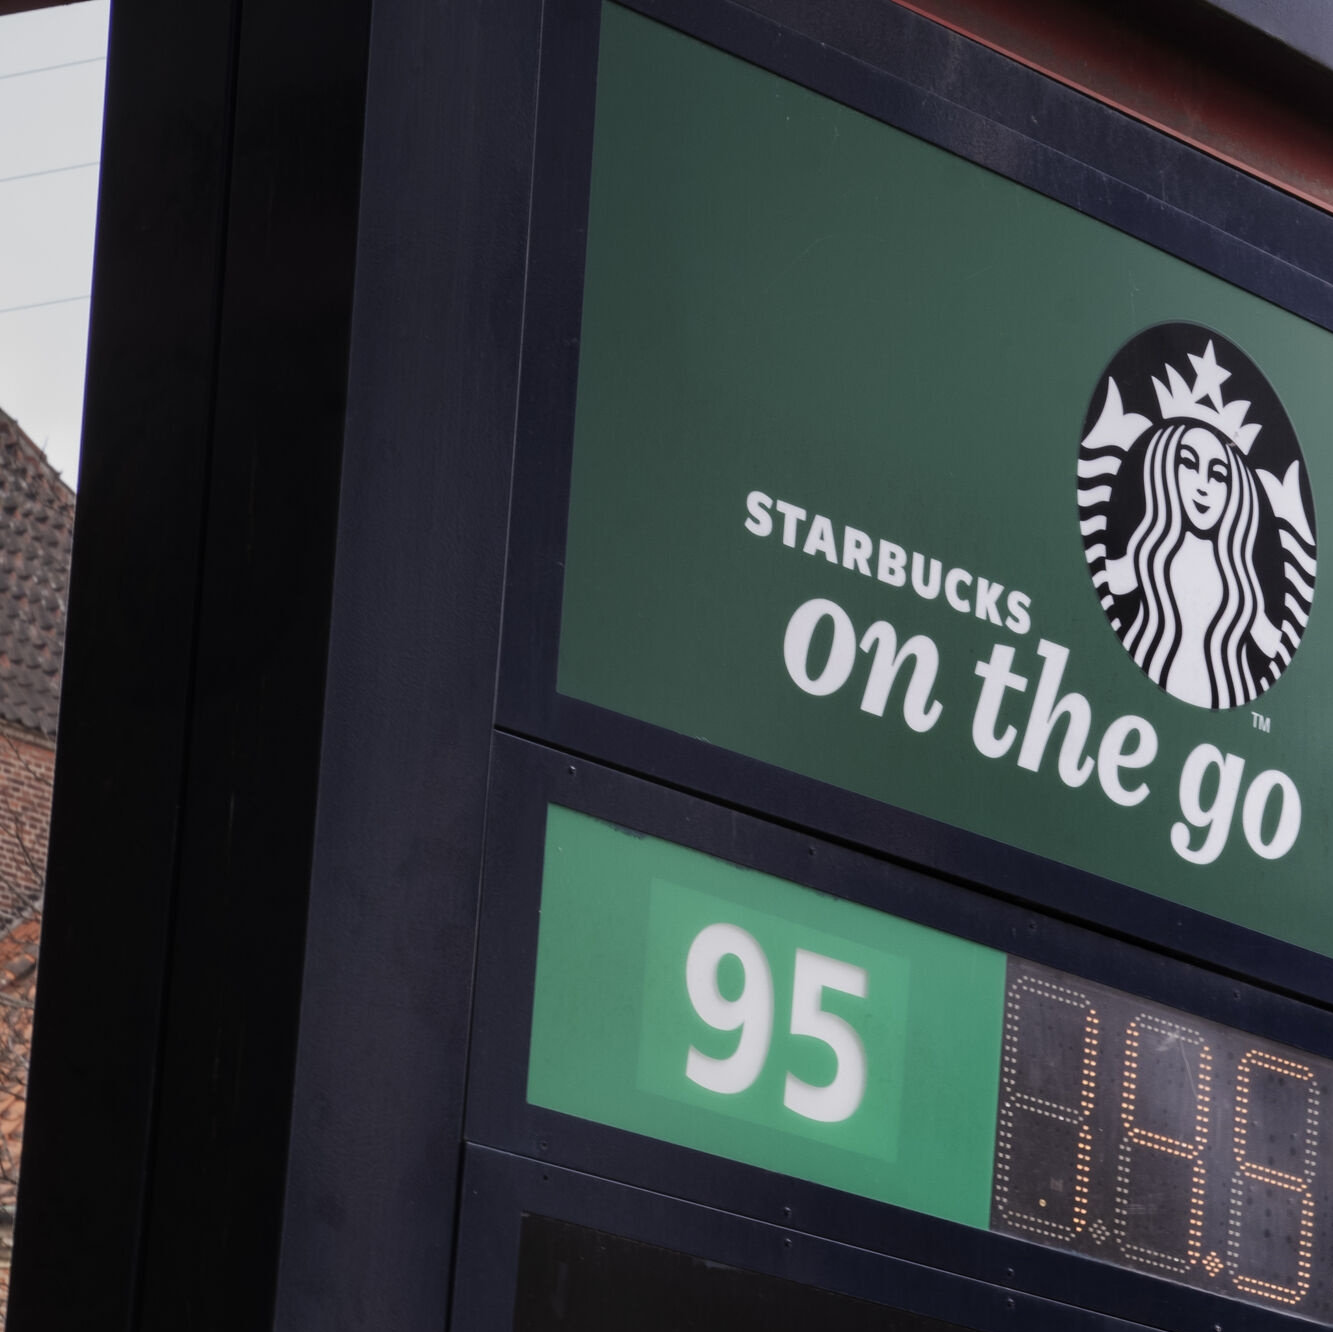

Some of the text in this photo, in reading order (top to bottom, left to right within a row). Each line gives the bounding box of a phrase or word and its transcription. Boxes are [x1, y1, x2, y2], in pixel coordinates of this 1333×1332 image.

[745, 490, 1033, 636] STARBUCKS
[783, 597, 1302, 866] on the go
[685, 923, 873, 1123] 95
